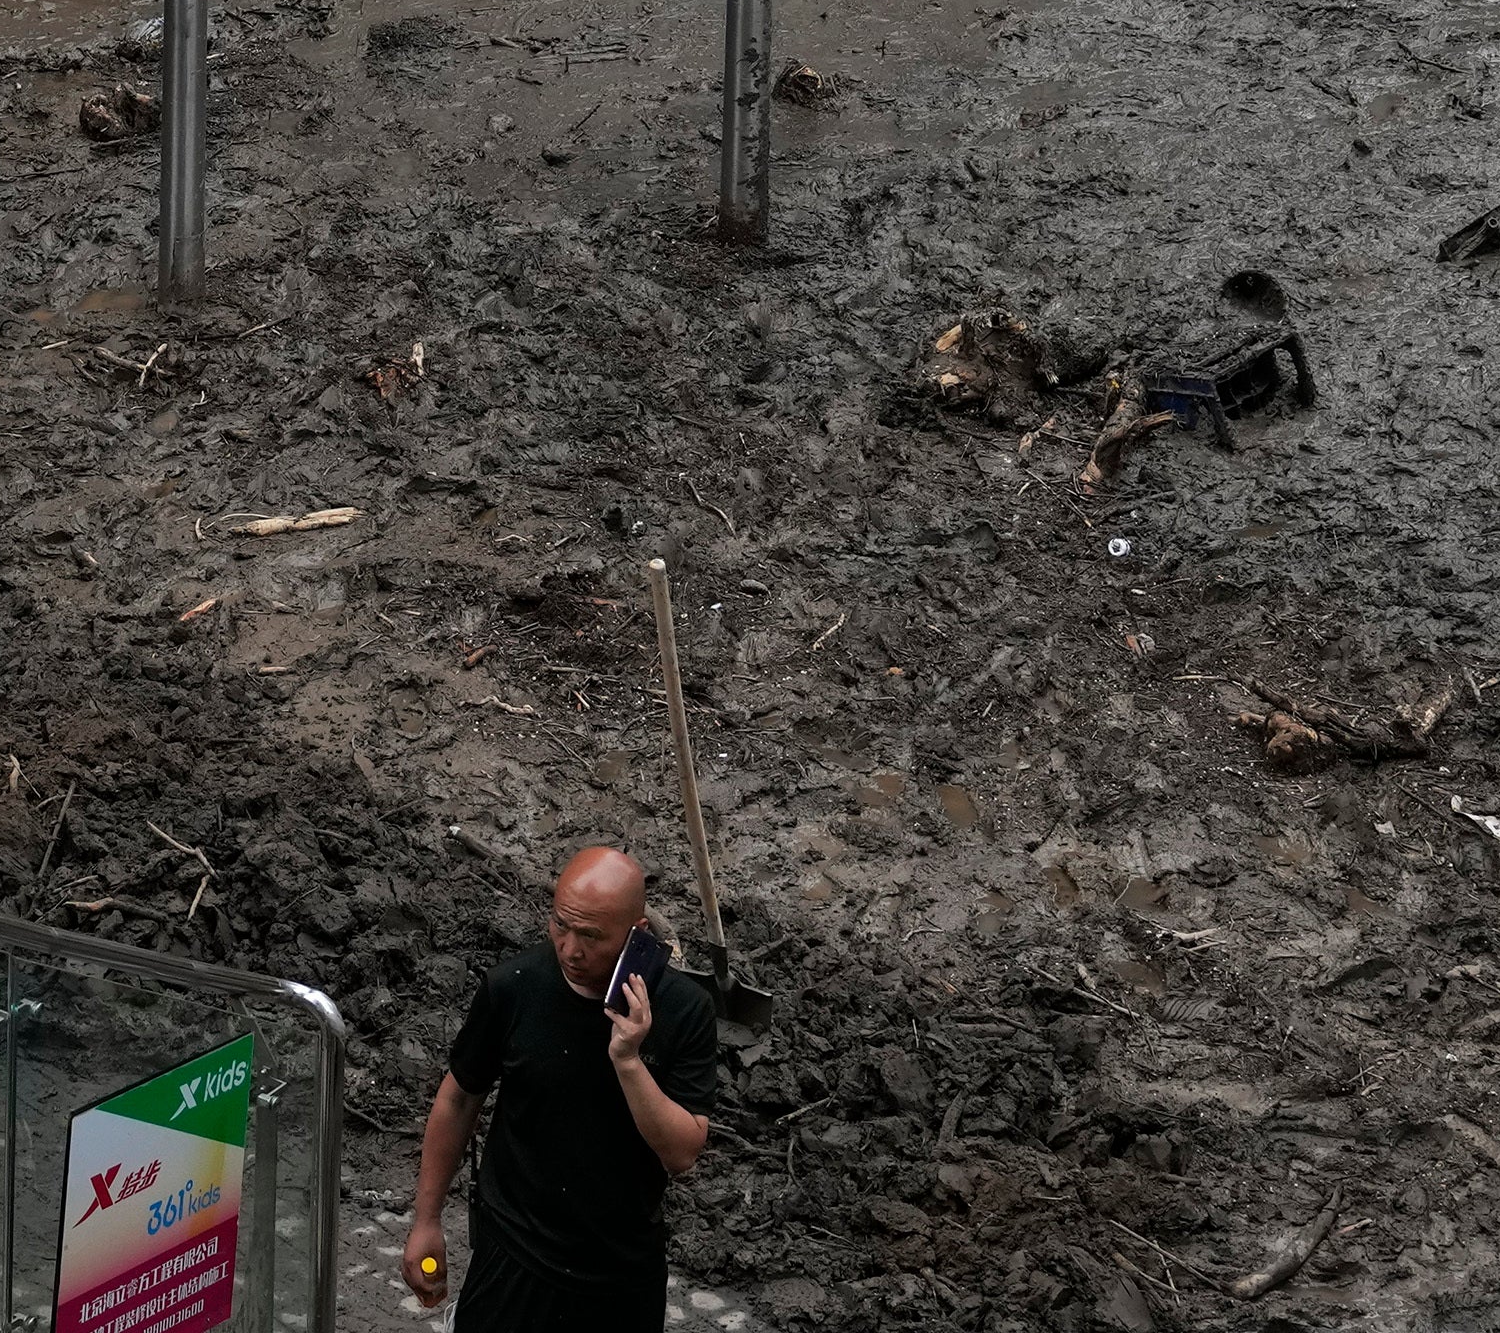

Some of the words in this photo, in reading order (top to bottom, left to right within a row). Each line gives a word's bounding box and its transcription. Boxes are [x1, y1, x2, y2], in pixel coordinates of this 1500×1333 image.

[203, 1059, 247, 1103] kids
[187, 1183, 222, 1218] kids
[78, 1235, 220, 1325] 北京海立睿方工程有限公司
